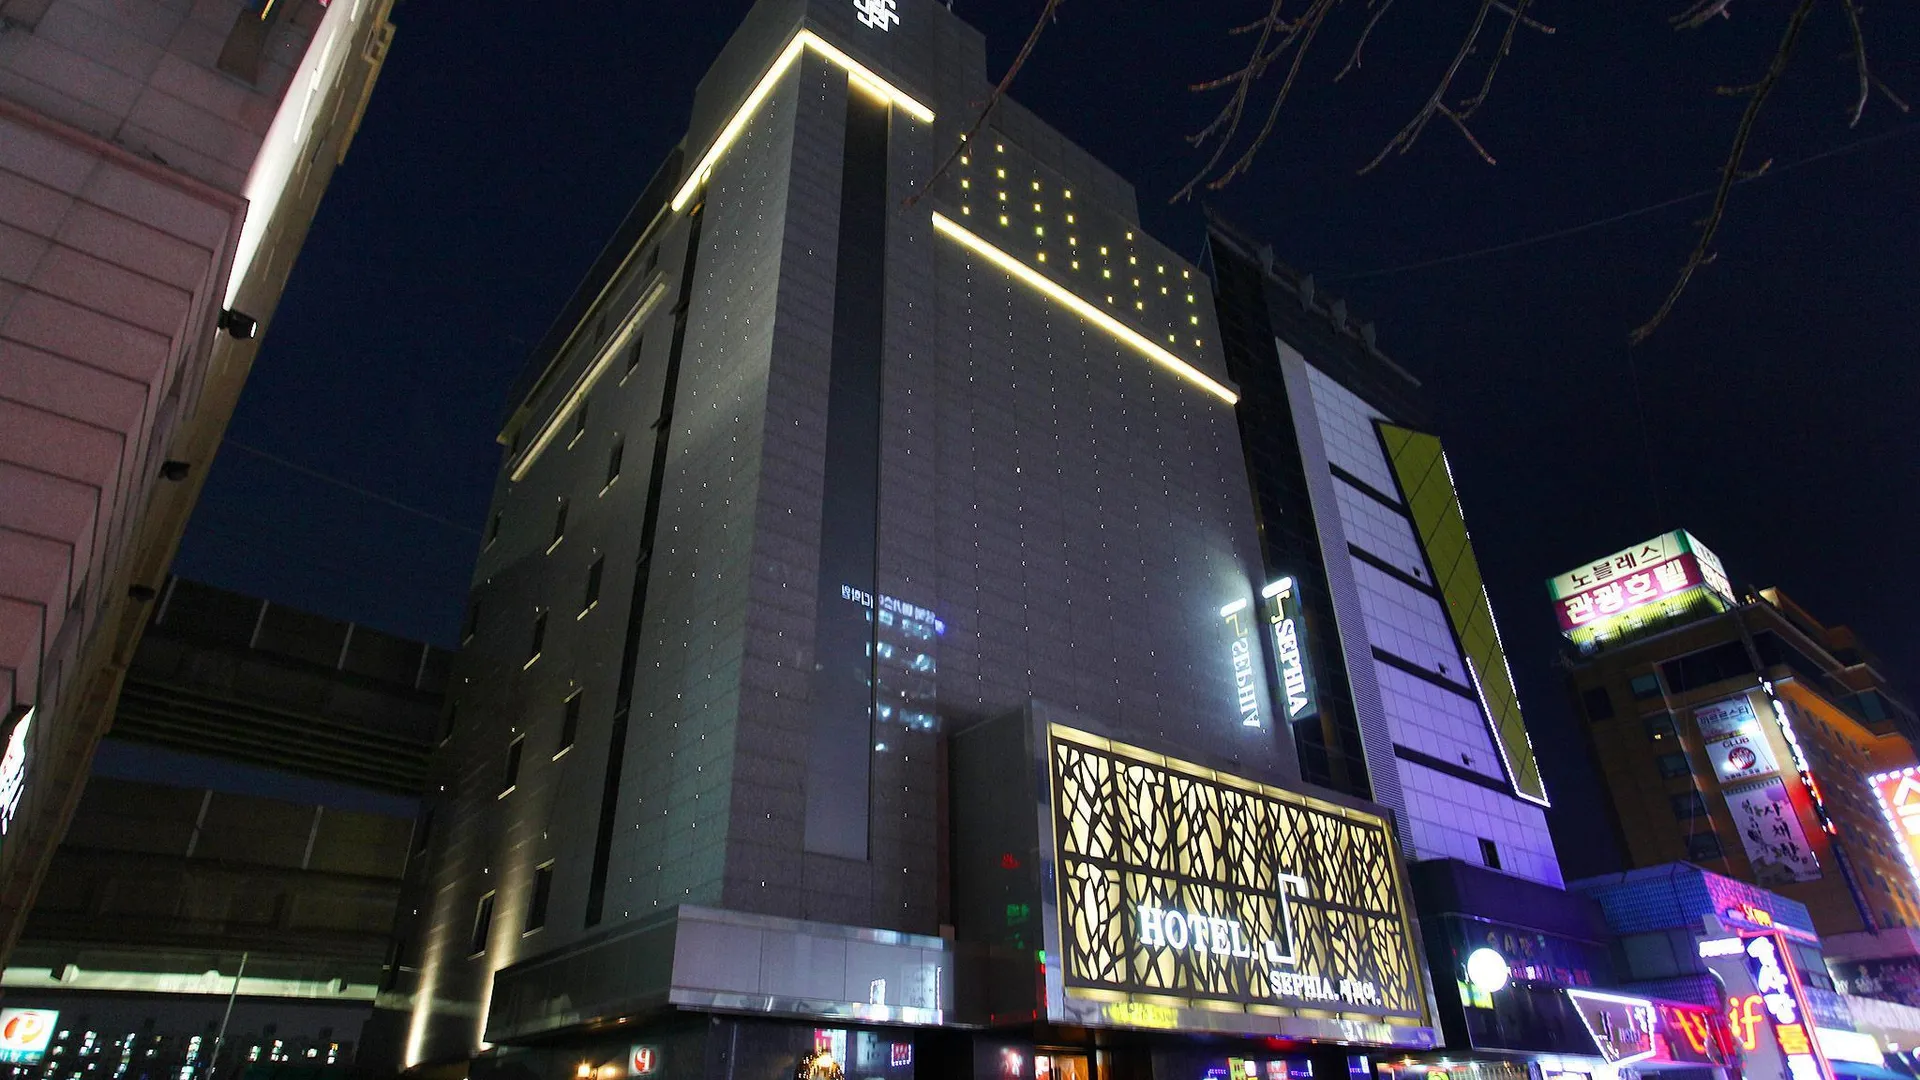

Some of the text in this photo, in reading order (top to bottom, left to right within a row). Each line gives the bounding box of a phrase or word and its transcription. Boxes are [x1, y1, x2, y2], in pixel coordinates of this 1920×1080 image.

[1564, 558, 1689, 625] 관광호텔
[1570, 544, 1663, 590] 노블레스
[1274, 617, 1310, 718] SEPHIA
[1722, 737, 1750, 749] CLUB
